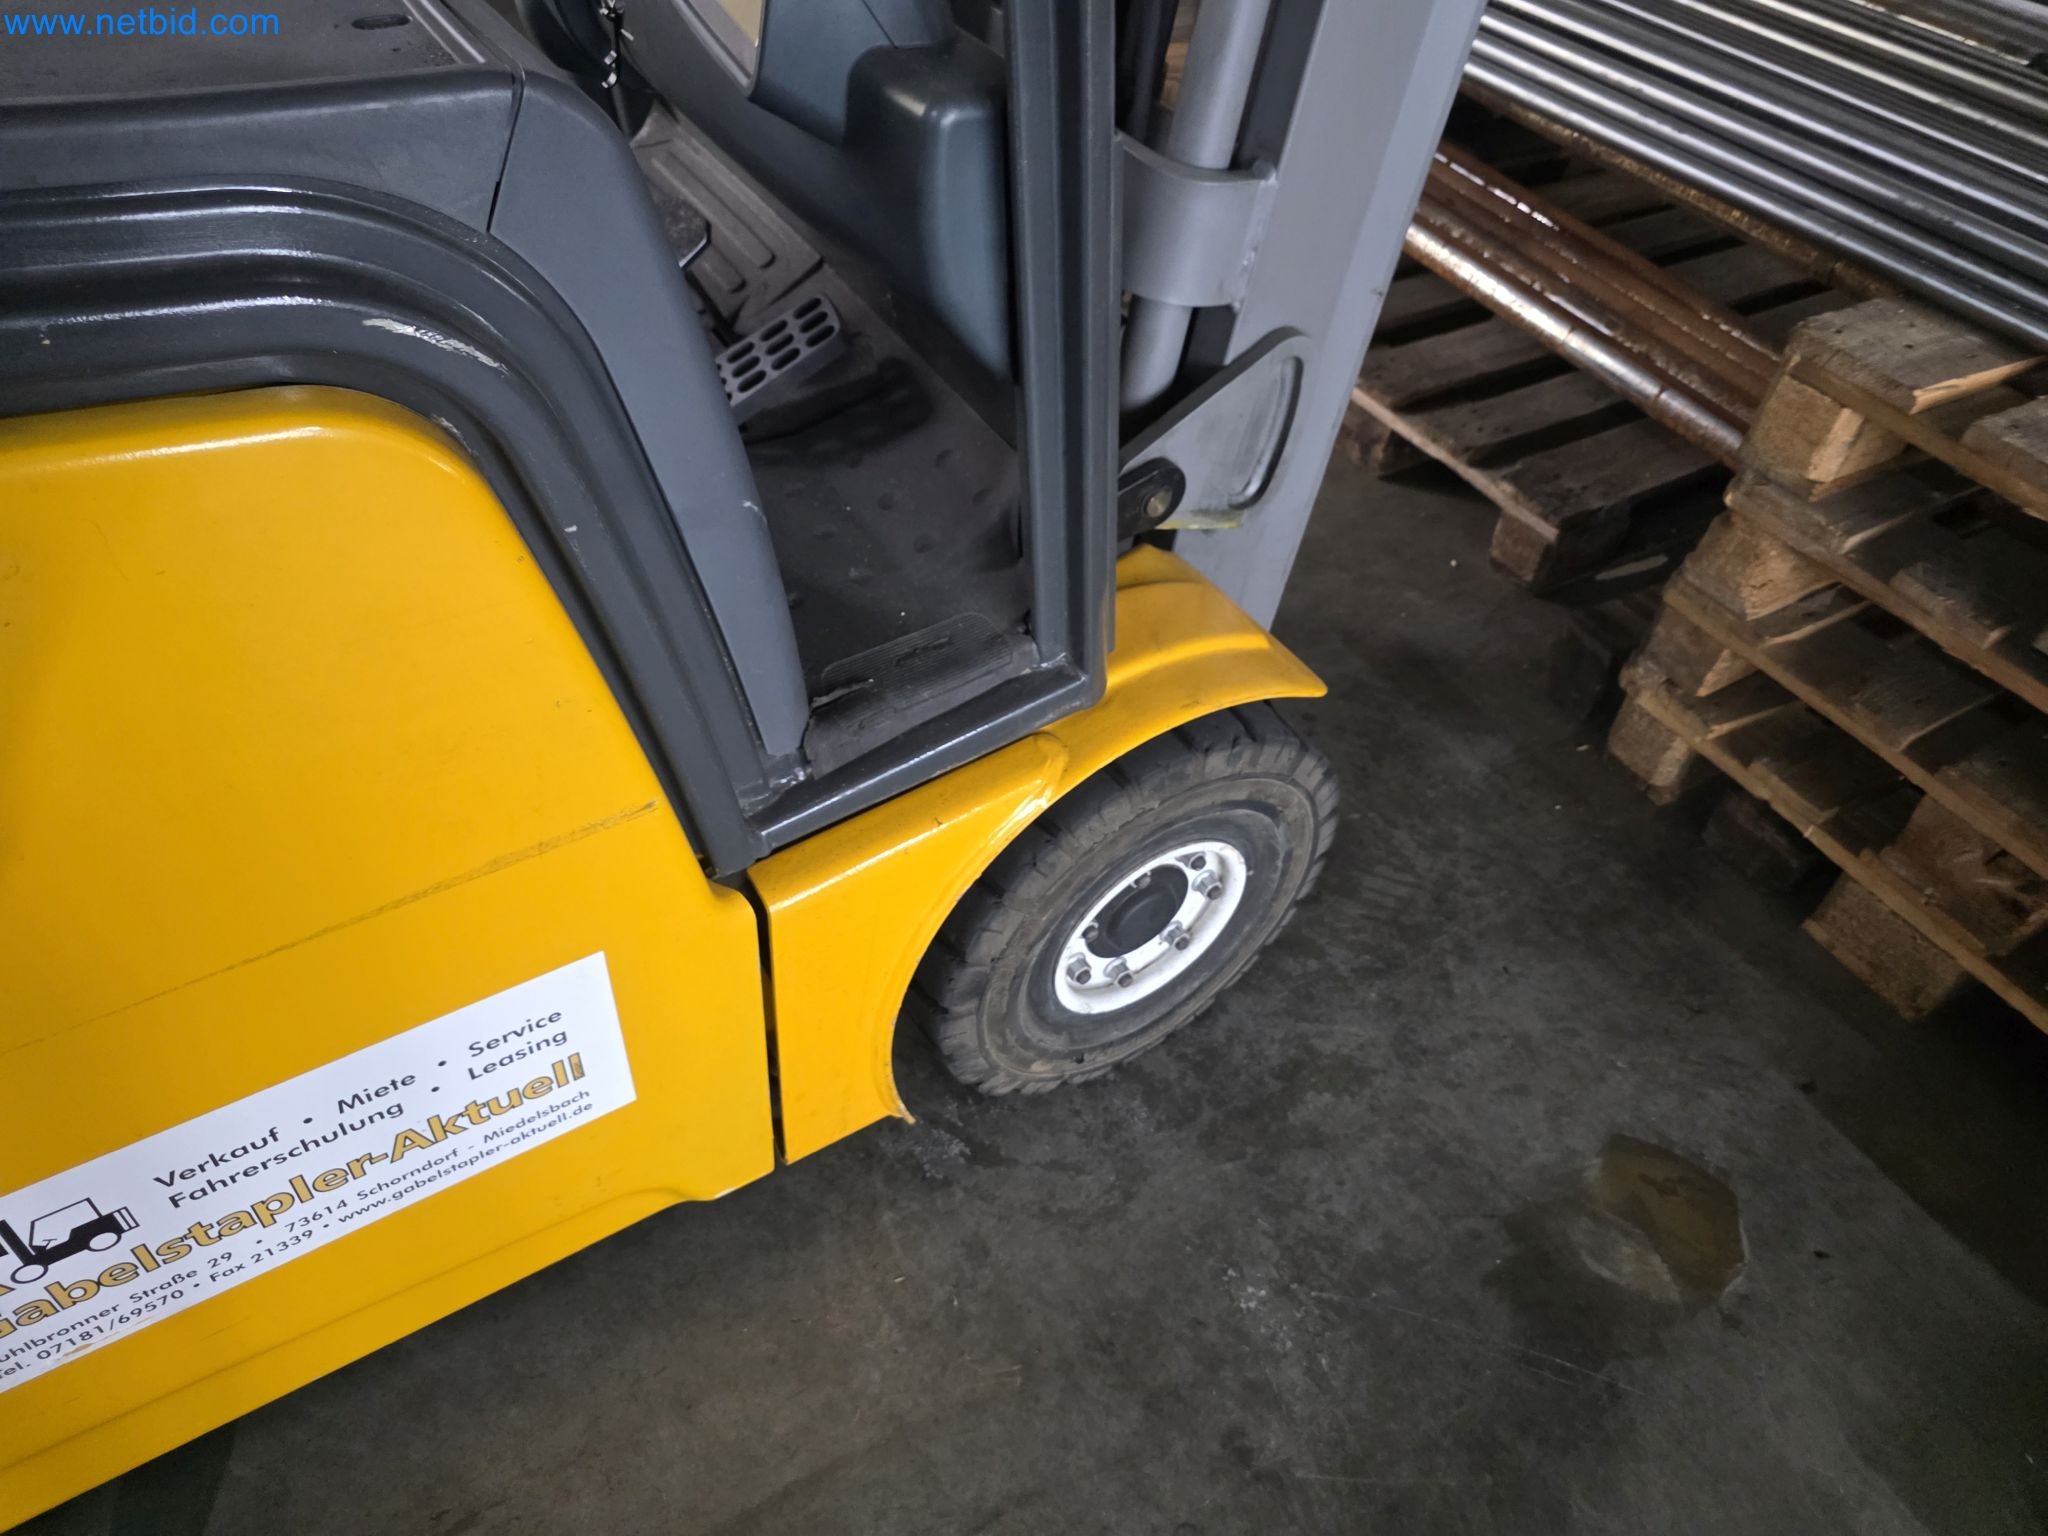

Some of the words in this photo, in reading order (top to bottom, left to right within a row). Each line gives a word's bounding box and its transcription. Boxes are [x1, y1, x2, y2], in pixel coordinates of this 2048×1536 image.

[153, 1126, 281, 1188] Verkauf
[337, 1073, 417, 1114] Miete
[468, 1011, 563, 1057] Service
[168, 1102, 404, 1208] Fahrerschulung
[468, 1031, 568, 1080] Leasing
[0, 1304, 120, 1363] uhlbronner
[129, 1268, 198, 1304] Straße
[207, 1251, 233, 1269] 29
[284, 1199, 348, 1233] 73614
[357, 1147, 459, 1201] Schorndorf
[483, 1089, 591, 1144] Miedelsbach
[0, 1361, 31, 1380] el.
[36, 1289, 184, 1360] 07181/69570
[209, 1262, 247, 1282] Fax
[250, 1229, 314, 1264] 21339
[338, 1101, 594, 1224] www.gabelstapler-aktuell.de
